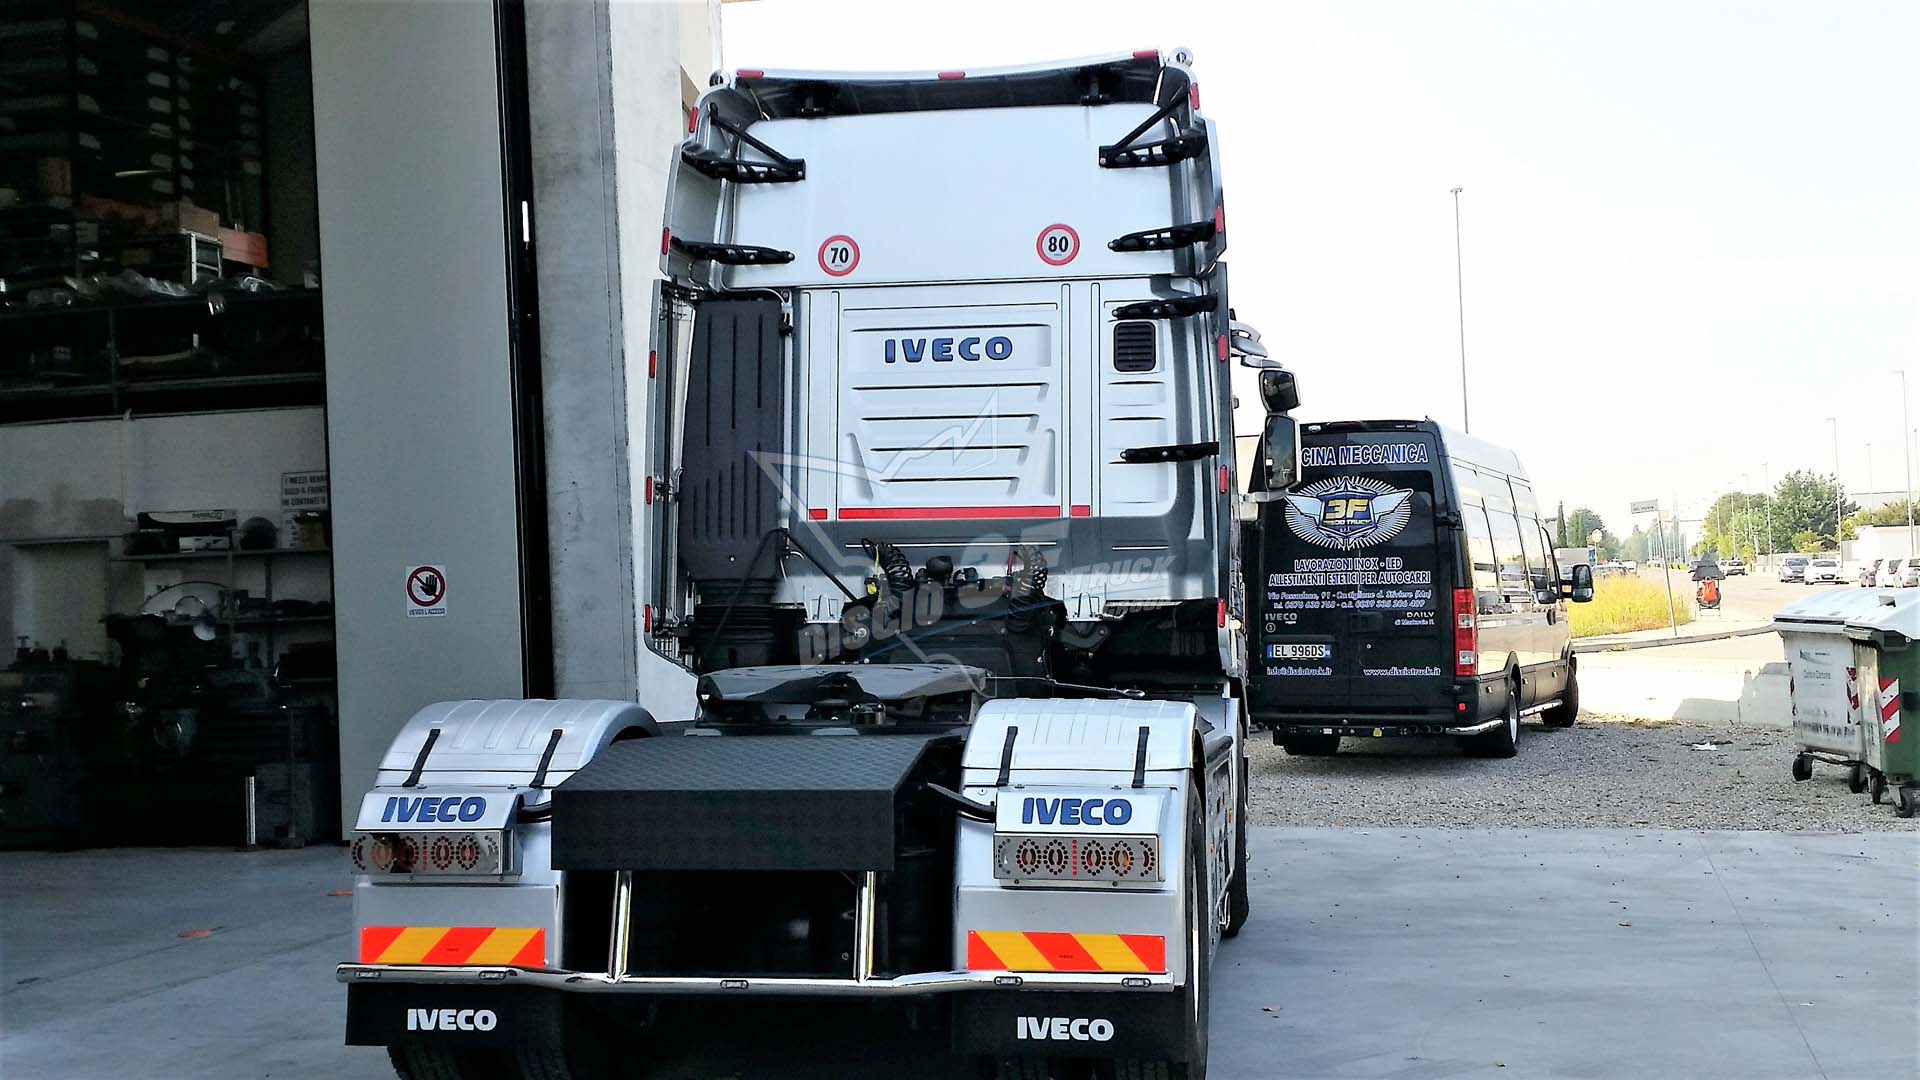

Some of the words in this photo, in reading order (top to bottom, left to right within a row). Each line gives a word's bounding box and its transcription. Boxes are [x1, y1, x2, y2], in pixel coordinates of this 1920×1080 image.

[830, 247, 849, 264] 70
[1048, 236, 1069, 253] 80
[884, 336, 1013, 363] IVECO
[1301, 446, 1337, 467] CINA
[1339, 444, 1429, 465] MECCANICA
[1325, 498, 1369, 520] 3F
[1354, 557, 1380, 571] INOX
[1386, 557, 1403, 570] LED
[1268, 572, 1326, 587] ALLESTIMENTI
[1327, 571, 1360, 585] ESTETICI
[1360, 571, 1378, 585] PER
[1378, 571, 1431, 584] AUTOCARRI
[1265, 612, 1298, 621] IVECO
[1274, 645, 1288, 657] EL
[1291, 645, 1325, 657] 996DS
[381, 796, 487, 823] IVECO
[1022, 797, 1133, 826] IVECO
[407, 1008, 498, 1032] IVECO
[1016, 1016, 1115, 1042] IVECO
